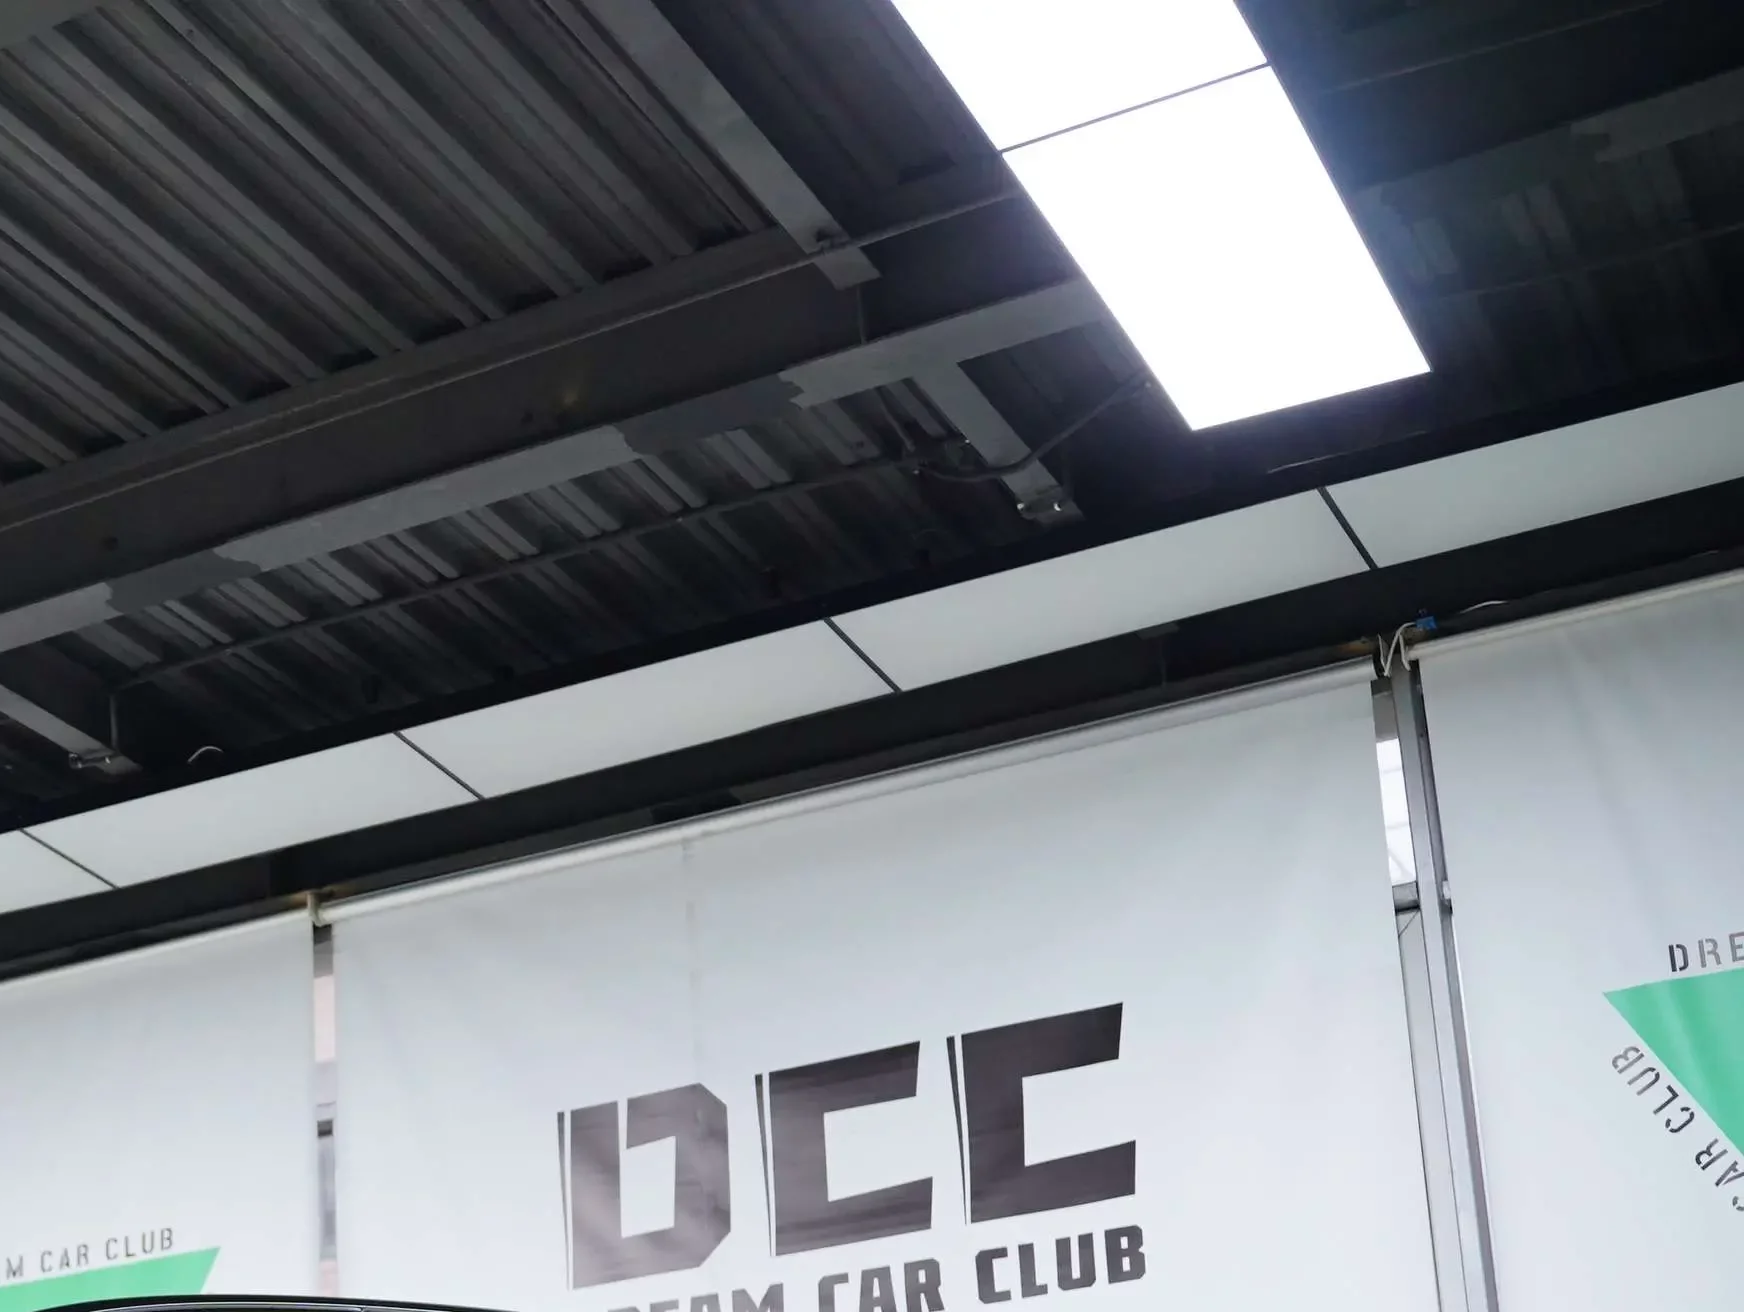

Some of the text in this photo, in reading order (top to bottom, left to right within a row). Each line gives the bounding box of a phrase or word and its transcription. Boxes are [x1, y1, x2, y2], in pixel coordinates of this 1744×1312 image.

[1611, 1045, 1696, 1134] CLUB
[557, 1002, 1136, 1291] DCC
[40, 1243, 90, 1274] CAR
[105, 1227, 175, 1260] CLUB
[974, 1224, 1146, 1305] CLUB
